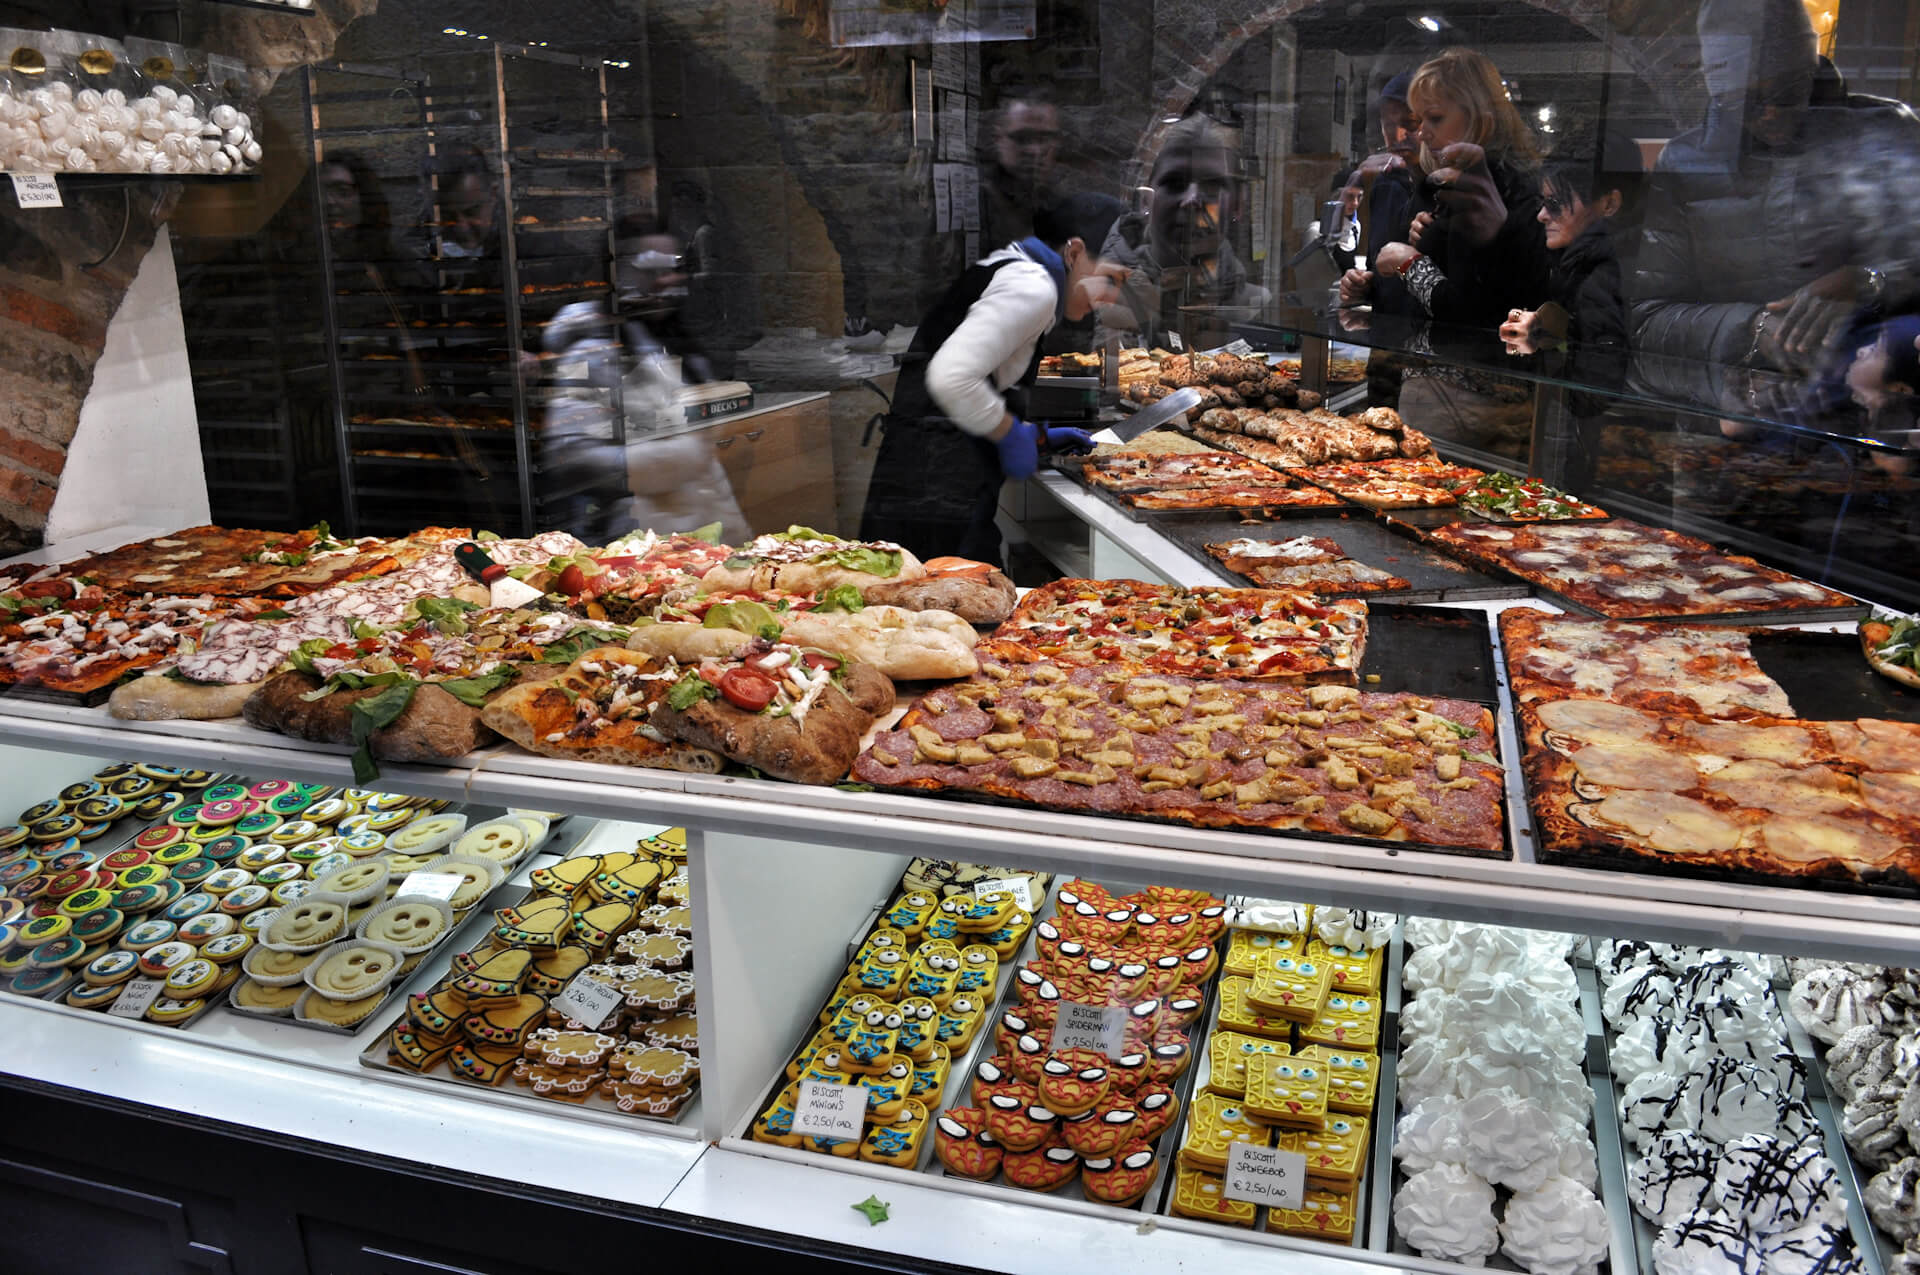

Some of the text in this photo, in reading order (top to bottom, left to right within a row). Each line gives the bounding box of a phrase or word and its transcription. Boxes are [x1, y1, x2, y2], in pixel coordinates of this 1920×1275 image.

[1072, 1007, 1102, 1021] BISCOTTI
[1065, 1019, 1110, 1033] SPIDERMAN
[811, 1086, 844, 1099] BISCOTTI
[809, 1099, 845, 1111] MINIONS
[1243, 1150, 1276, 1165] BISCOTTI
